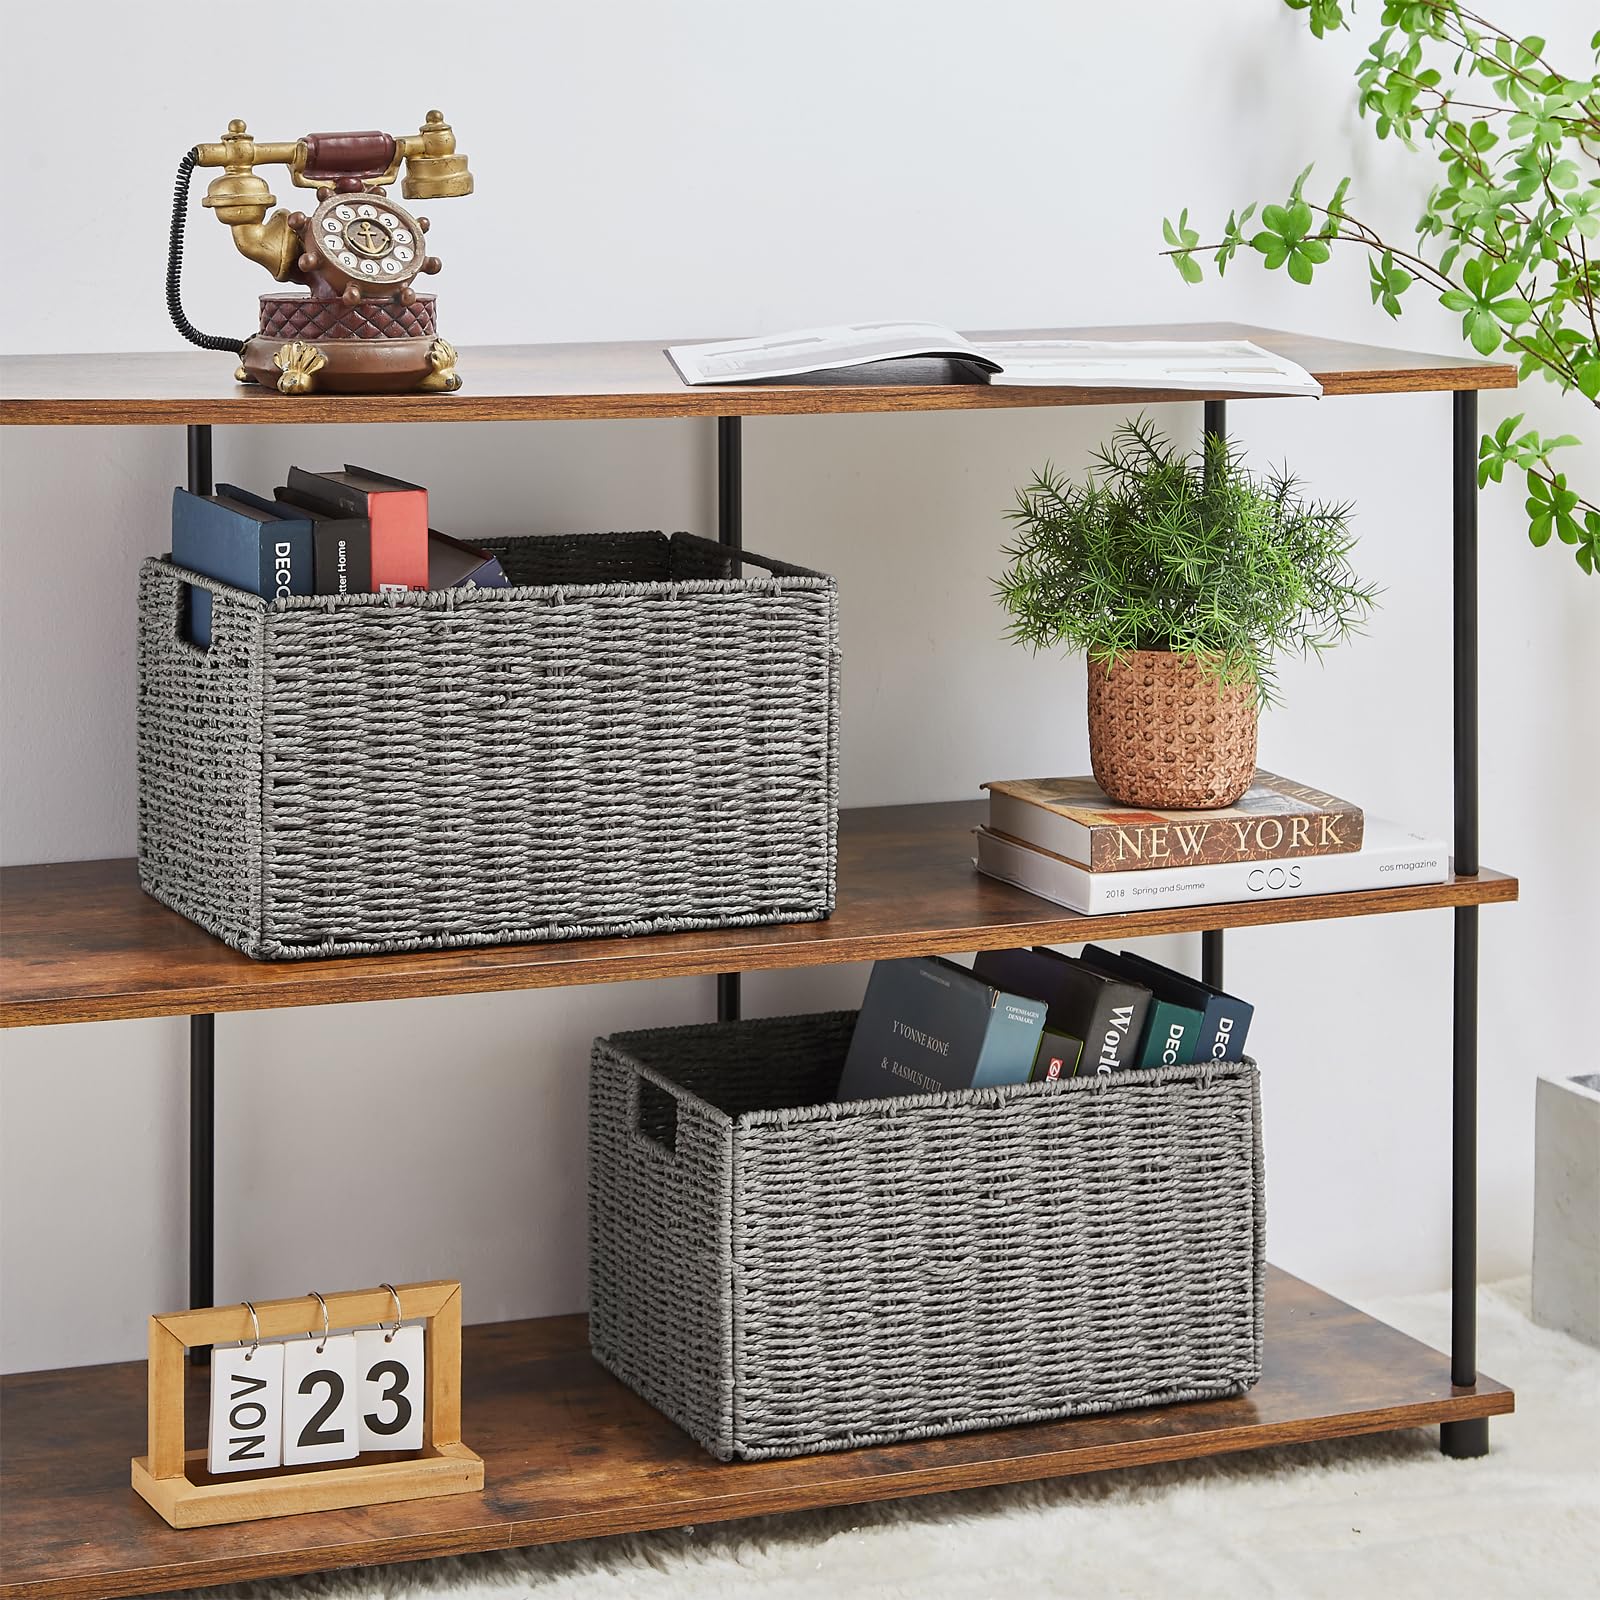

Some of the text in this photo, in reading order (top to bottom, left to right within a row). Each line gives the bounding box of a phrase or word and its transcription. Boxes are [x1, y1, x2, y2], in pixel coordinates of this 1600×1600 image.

[341, 210, 351, 219] 5
[363, 209, 372, 218] 4
[327, 222, 337, 231] 6
[384, 218, 393, 227] 3
[327, 239, 336, 248] 7
[396, 233, 406, 242] 2
[343, 256, 351, 266] 8
[400, 251, 409, 259] 1
[365, 263, 374, 274] 9
[386, 262, 395, 271] 0
[337, 540, 347, 572] Home
[1115, 814, 1344, 861] NEW YORK
[1379, 860, 1438, 872] cos magazine
[1246, 865, 1303, 892] COS
[1105, 889, 1125, 899] 2018
[1132, 887, 1158, 896] Spring
[1158, 885, 1175, 893] and
[1005, 1005, 1040, 1019] COPENHAGEN
[1008, 1013, 1035, 1025] DENMARK
[1162, 1023, 1185, 1066] DEC
[1212, 1017, 1234, 1060] DEC
[881, 1056, 889, 1070] &
[891, 1061, 924, 1086] RASMUS
[228, 1374, 268, 1462] NOV
